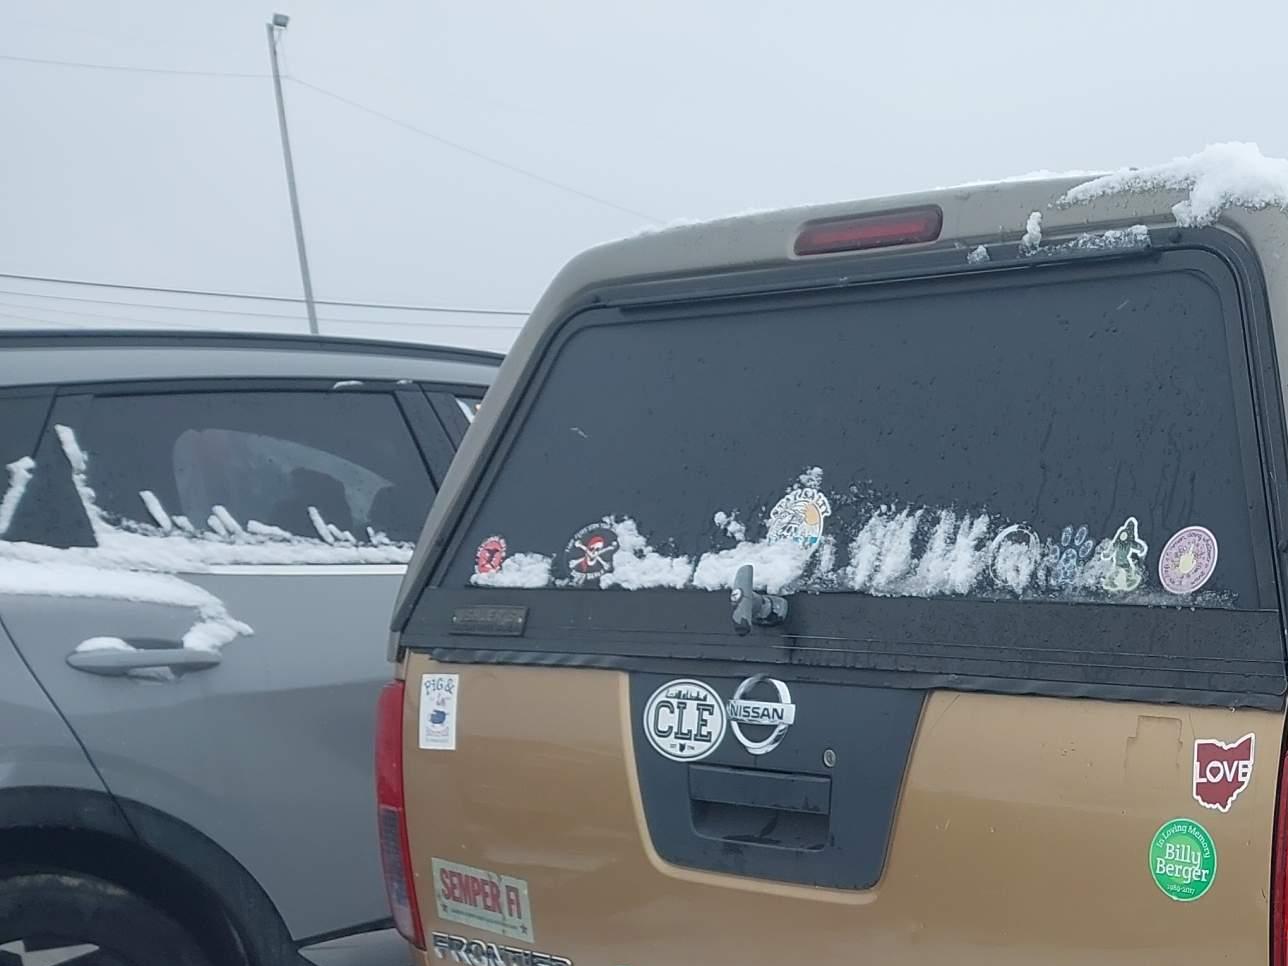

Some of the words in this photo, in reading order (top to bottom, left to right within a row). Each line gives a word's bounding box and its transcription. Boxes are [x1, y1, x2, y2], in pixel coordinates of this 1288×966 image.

[653, 700, 715, 742] CLE
[729, 703, 785, 721] NISSAN
[1195, 760, 1253, 783] LOVE
[1162, 824, 1187, 840] Loving
[1187, 825, 1211, 858] Memory
[1165, 843, 1202, 869] Billy
[1155, 857, 1209, 884] Berger
[440, 867, 502, 914] SEMPER
[505, 884, 522, 919] FI
